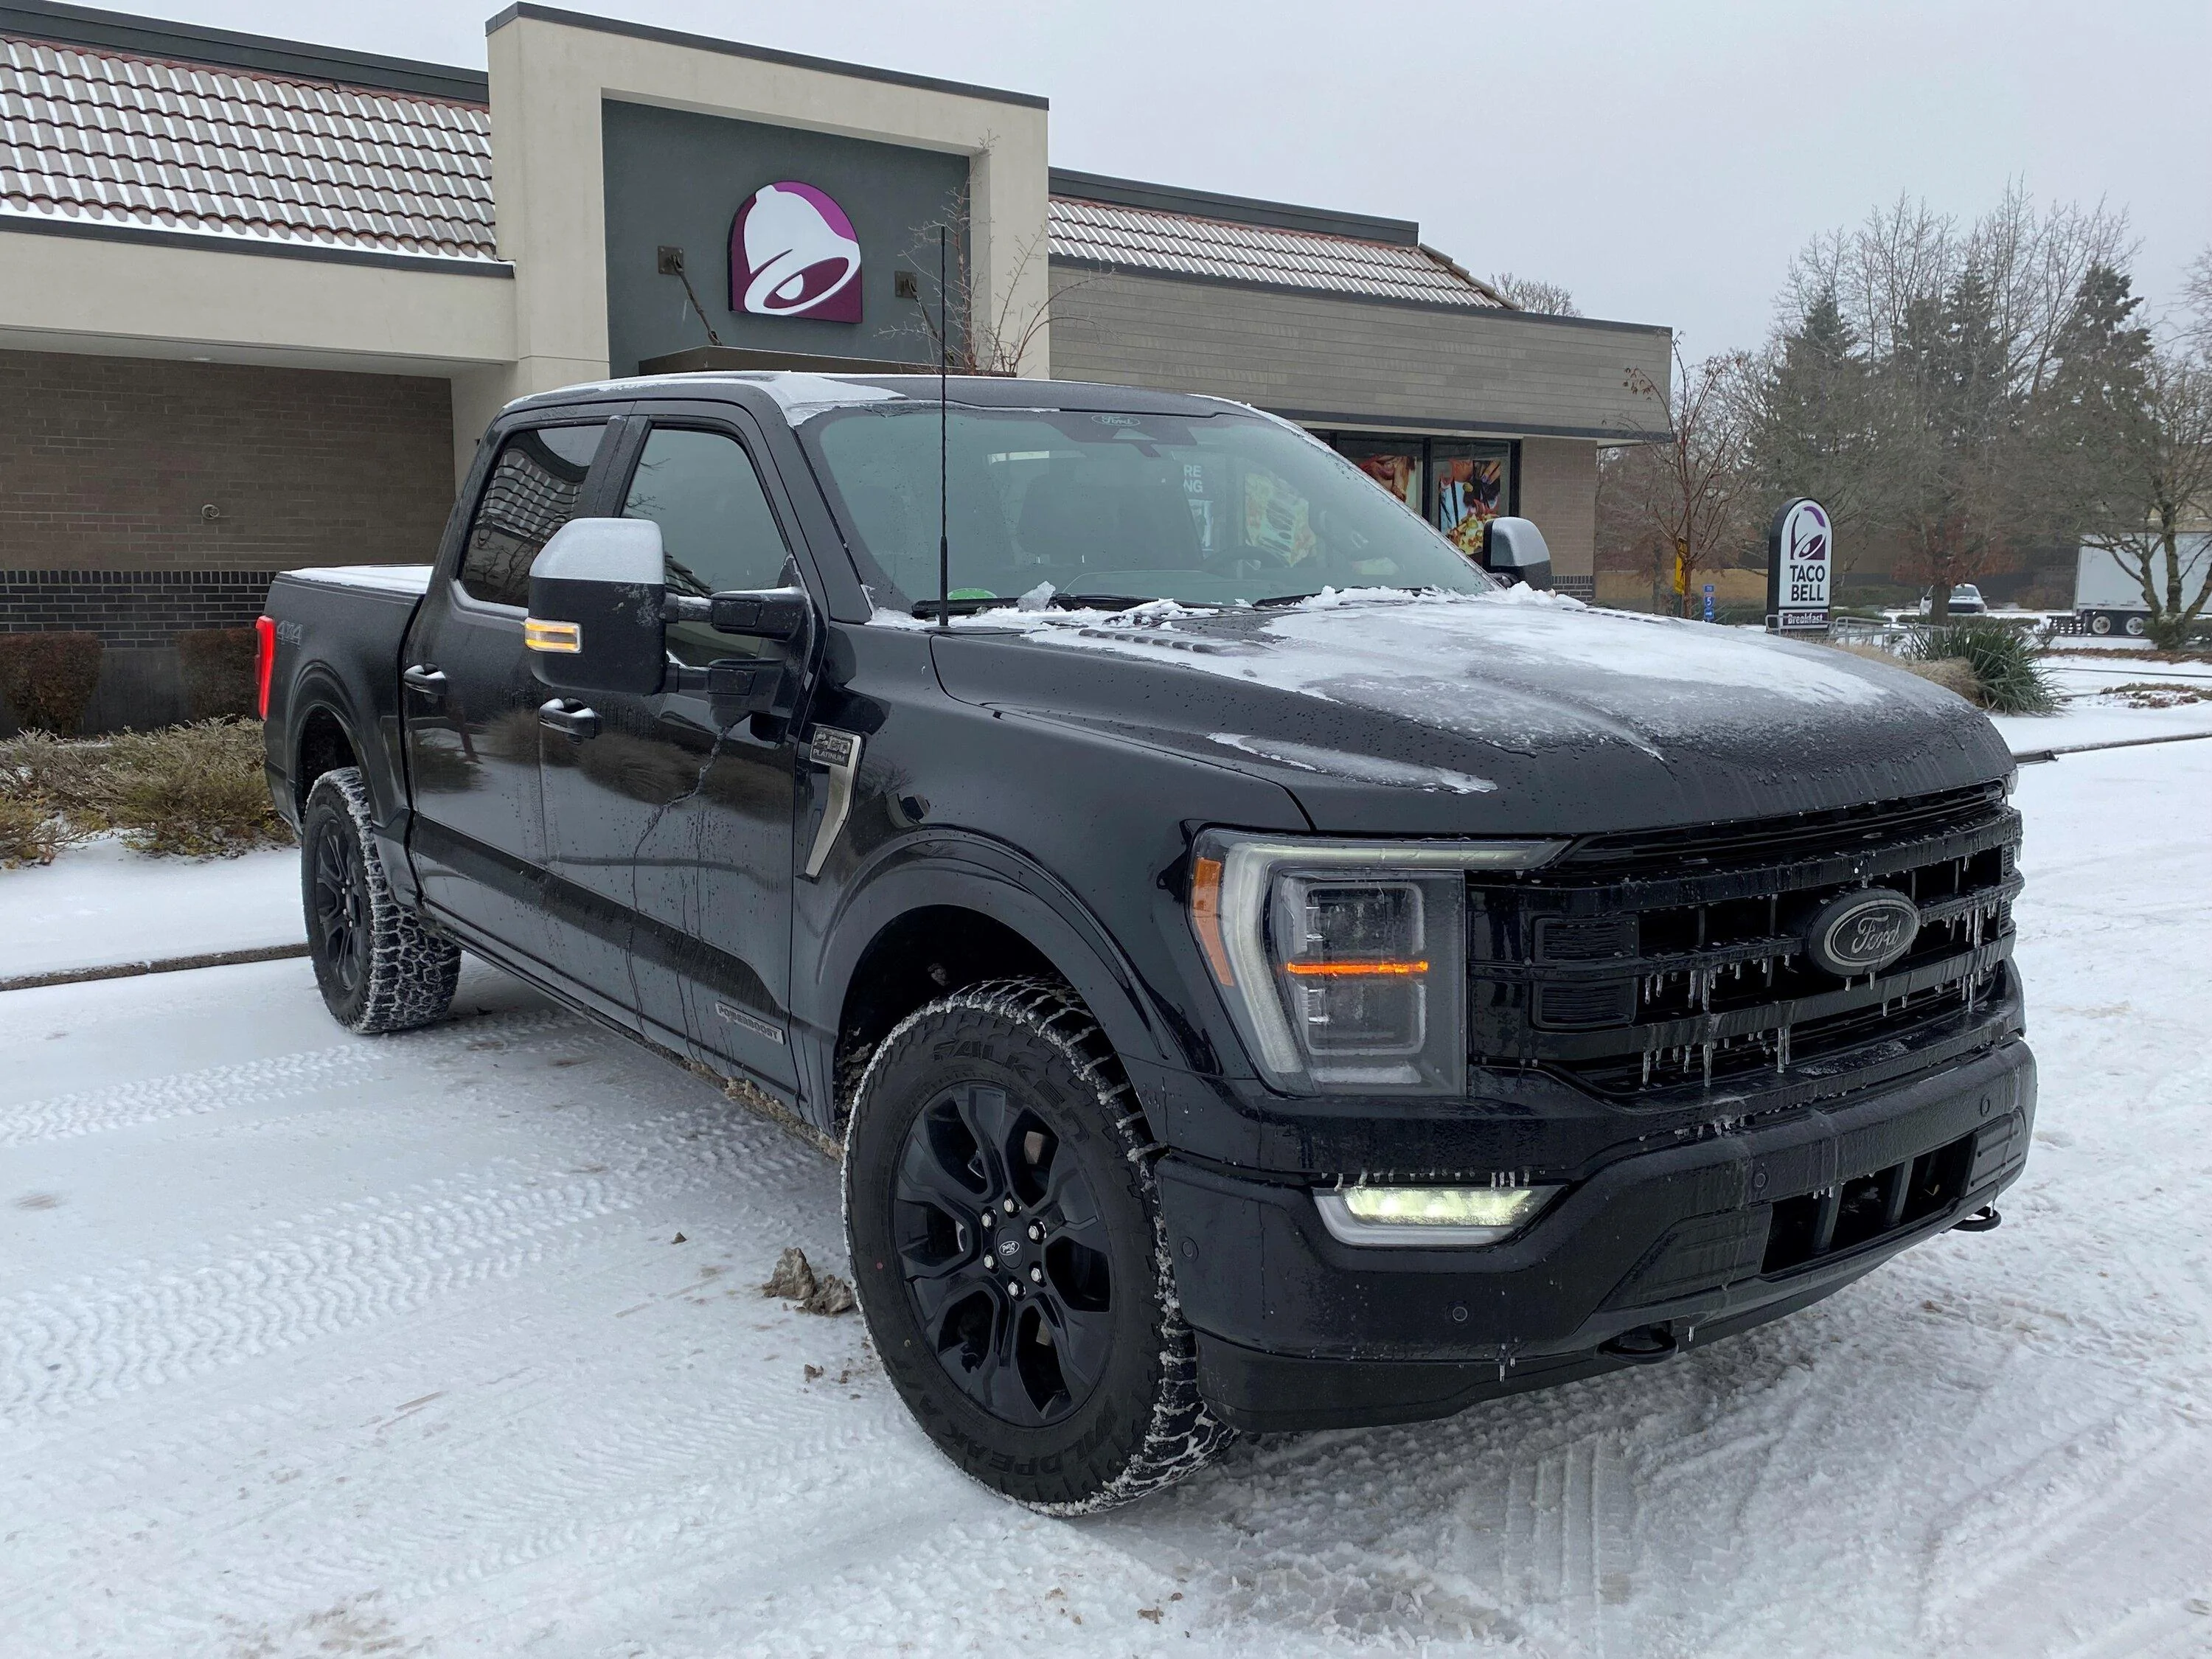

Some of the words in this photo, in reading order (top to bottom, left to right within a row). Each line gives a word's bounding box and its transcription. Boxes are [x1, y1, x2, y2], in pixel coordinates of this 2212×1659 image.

[1790, 565, 1825, 582] TACO
[1707, 597, 1711, 605] 5
[1791, 584, 1824, 602] BELL
[1788, 613, 1823, 624] Breakfast
[813, 748, 845, 762] PLATINUM
[1851, 914, 1902, 954] Ford
[717, 1005, 778, 1039] POWERBOOST
[933, 1038, 1089, 1143] FALKEN
[1002, 1242, 1015, 1253] Ford
[941, 1400, 1117, 1477] WILDPEAK
